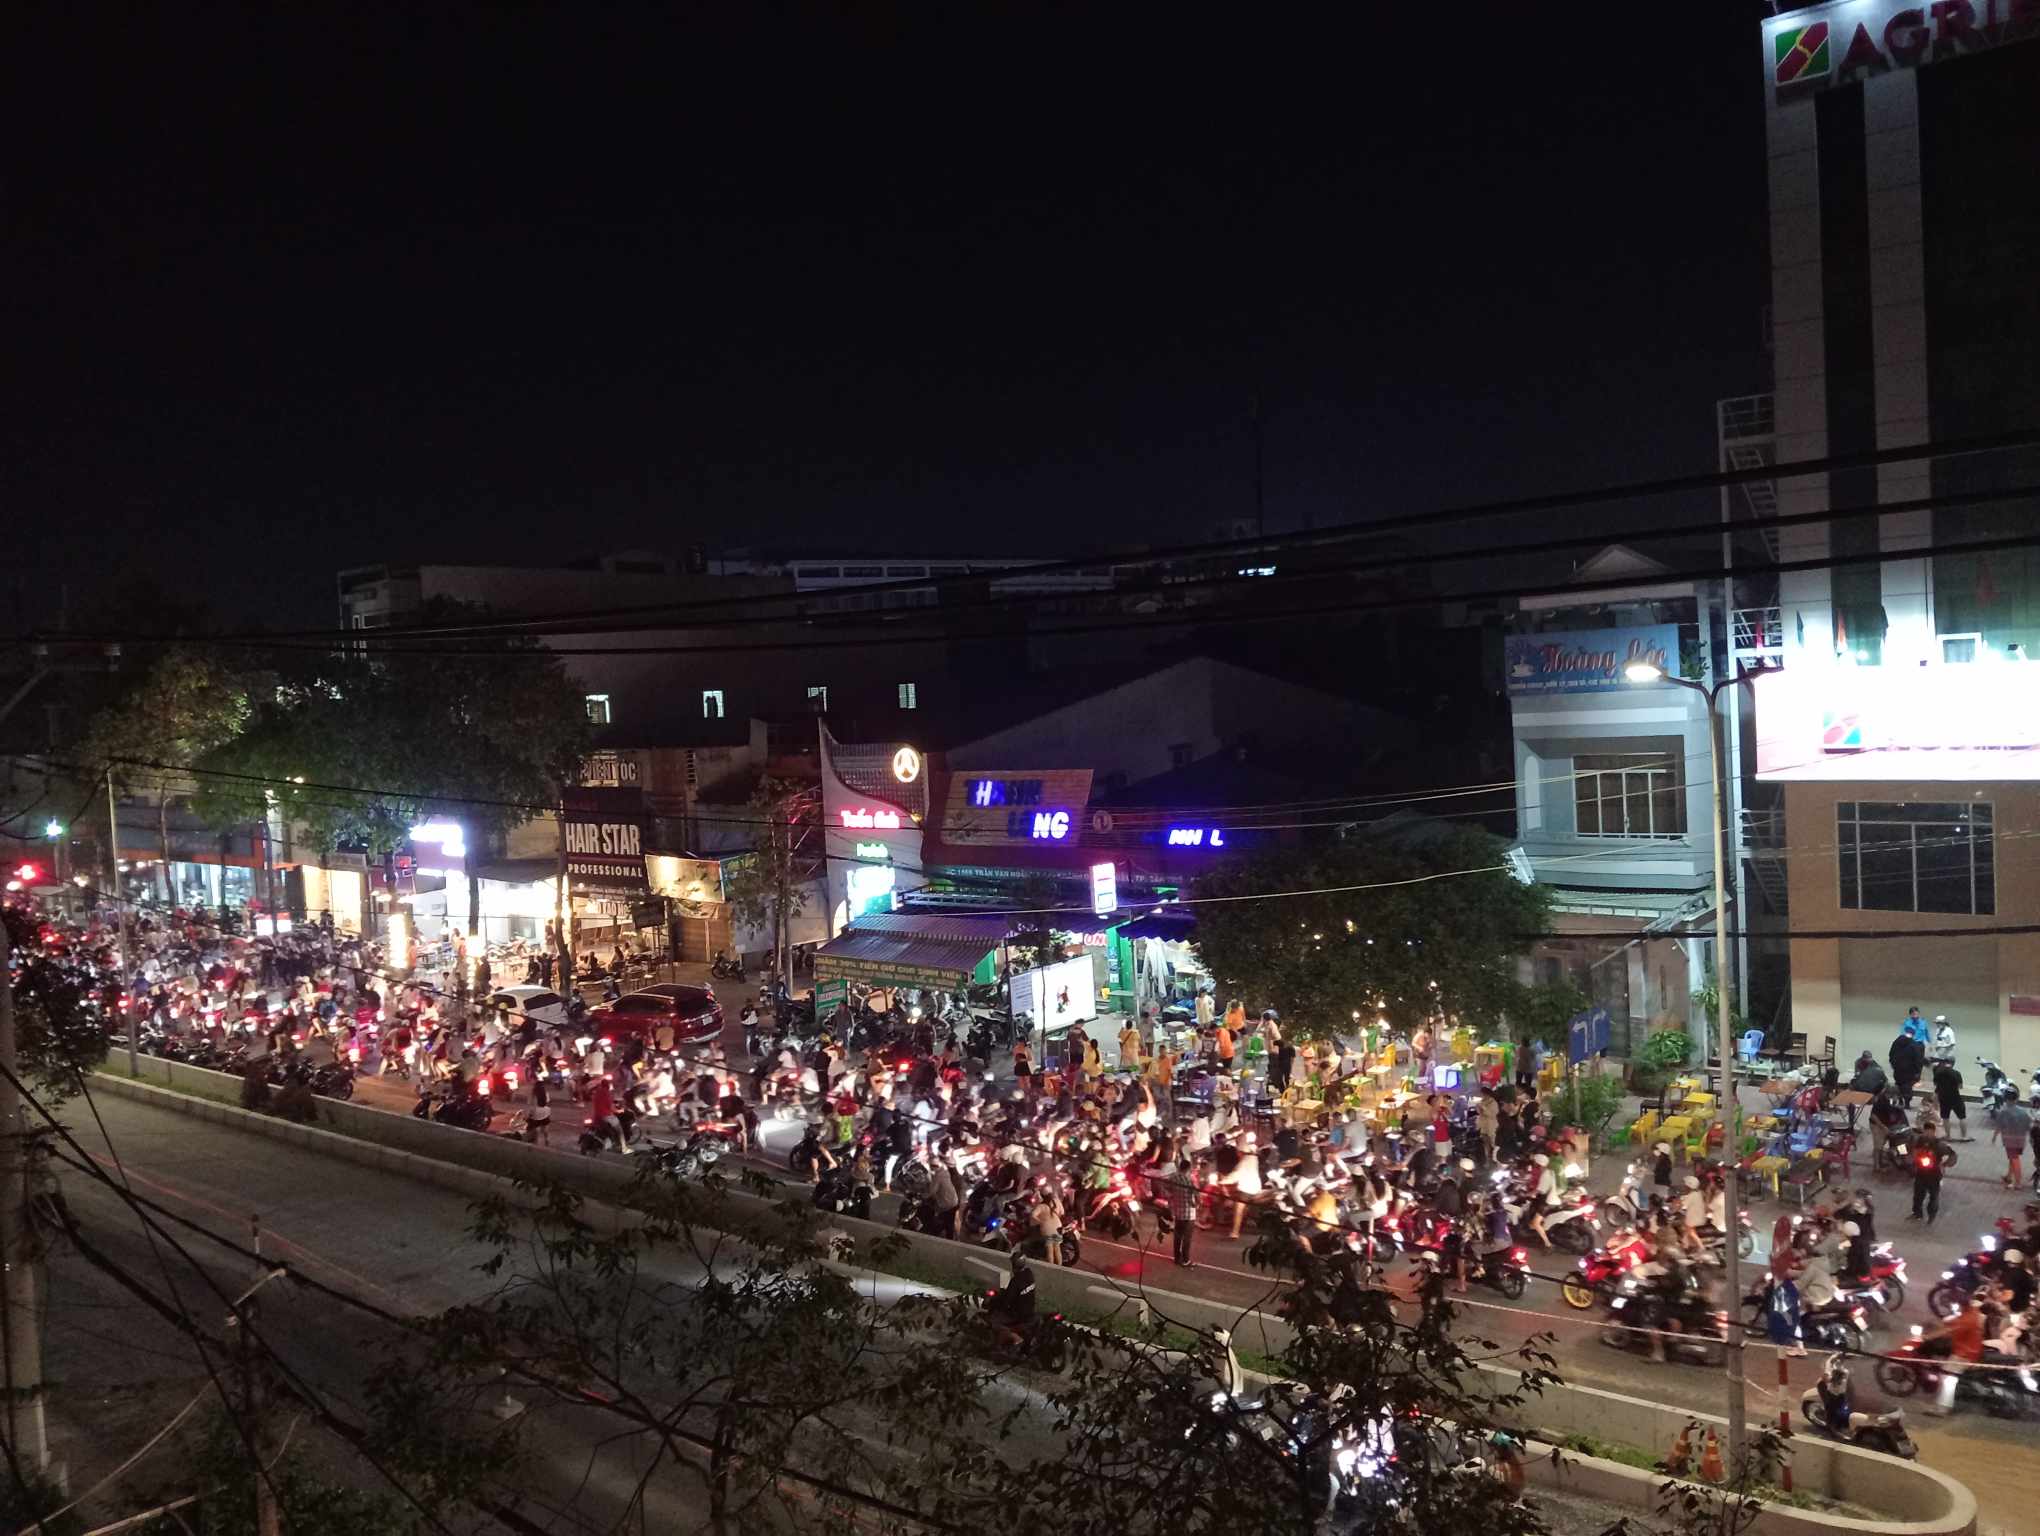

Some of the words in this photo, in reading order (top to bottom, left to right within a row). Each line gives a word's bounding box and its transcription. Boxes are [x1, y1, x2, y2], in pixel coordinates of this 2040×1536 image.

[565, 822, 601, 853] HAIR
[602, 823, 641, 856] STAR
[567, 863, 643, 878] PROFESSIONAL
